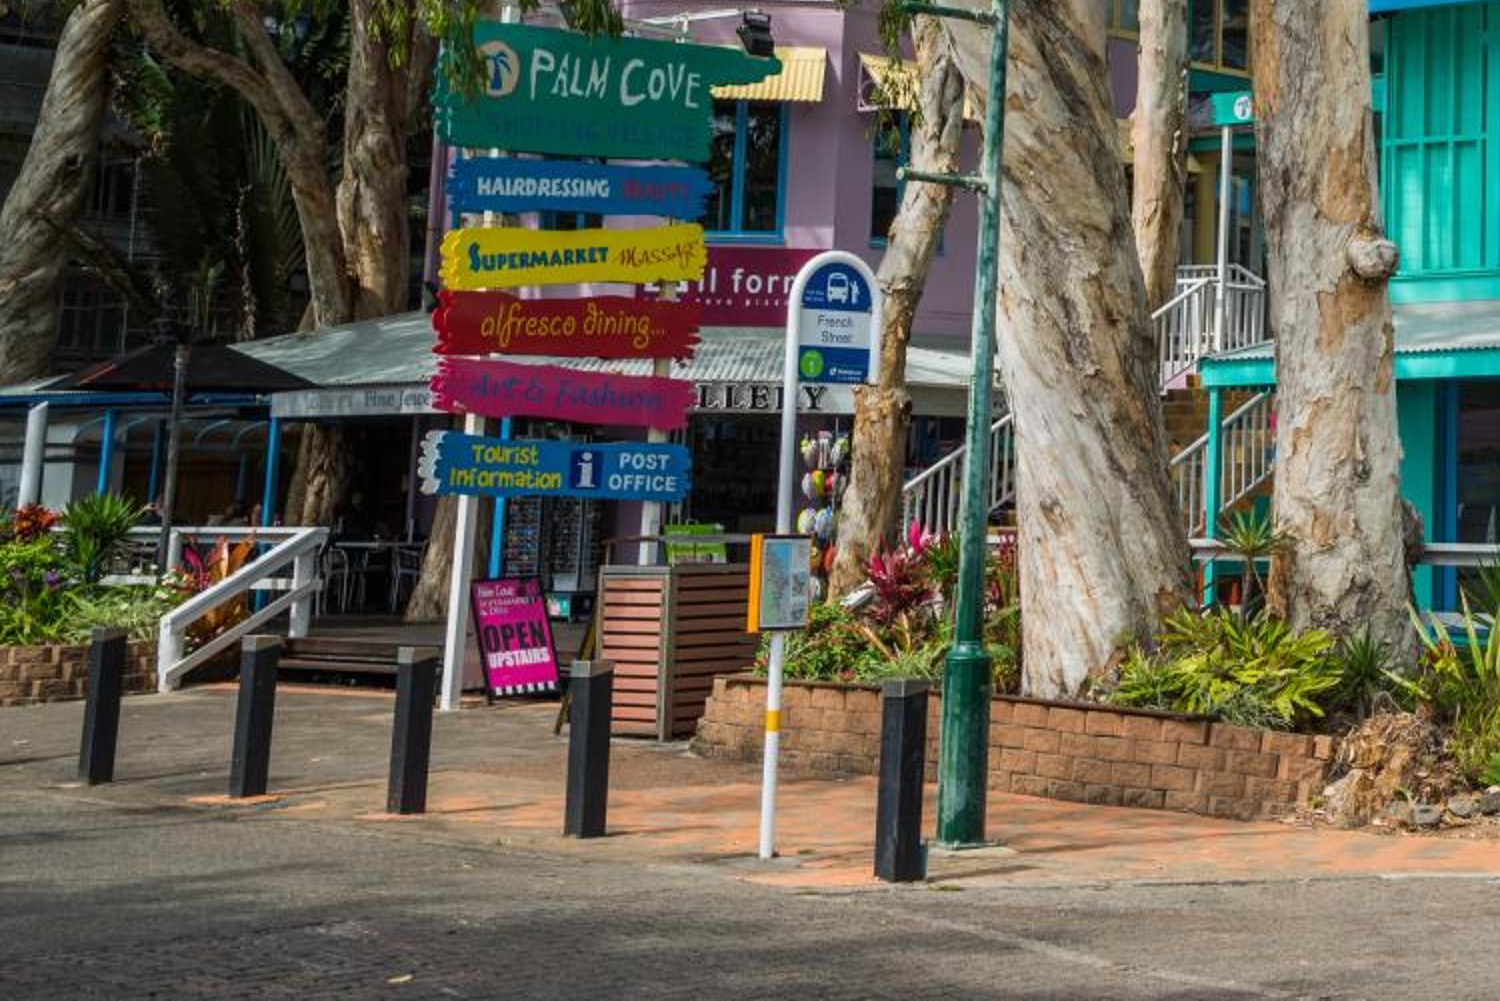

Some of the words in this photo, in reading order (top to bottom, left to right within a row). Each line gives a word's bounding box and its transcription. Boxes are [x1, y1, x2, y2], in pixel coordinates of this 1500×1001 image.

[530, 48, 609, 101] PALM
[620, 58, 701, 108] COVE
[477, 176, 611, 198] HAIRDRESSING
[469, 242, 609, 271] SUPERMARKET
[480, 304, 576, 347] alfresco
[817, 314, 854, 328] French
[821, 331, 853, 344] Street
[472, 445, 539, 466] Tourist
[619, 453, 671, 471] POST
[450, 465, 561, 490] Information
[608, 474, 677, 493] OFFICE
[483, 619, 548, 653] OPEN
[487, 648, 550, 669] UPSTAIRS
